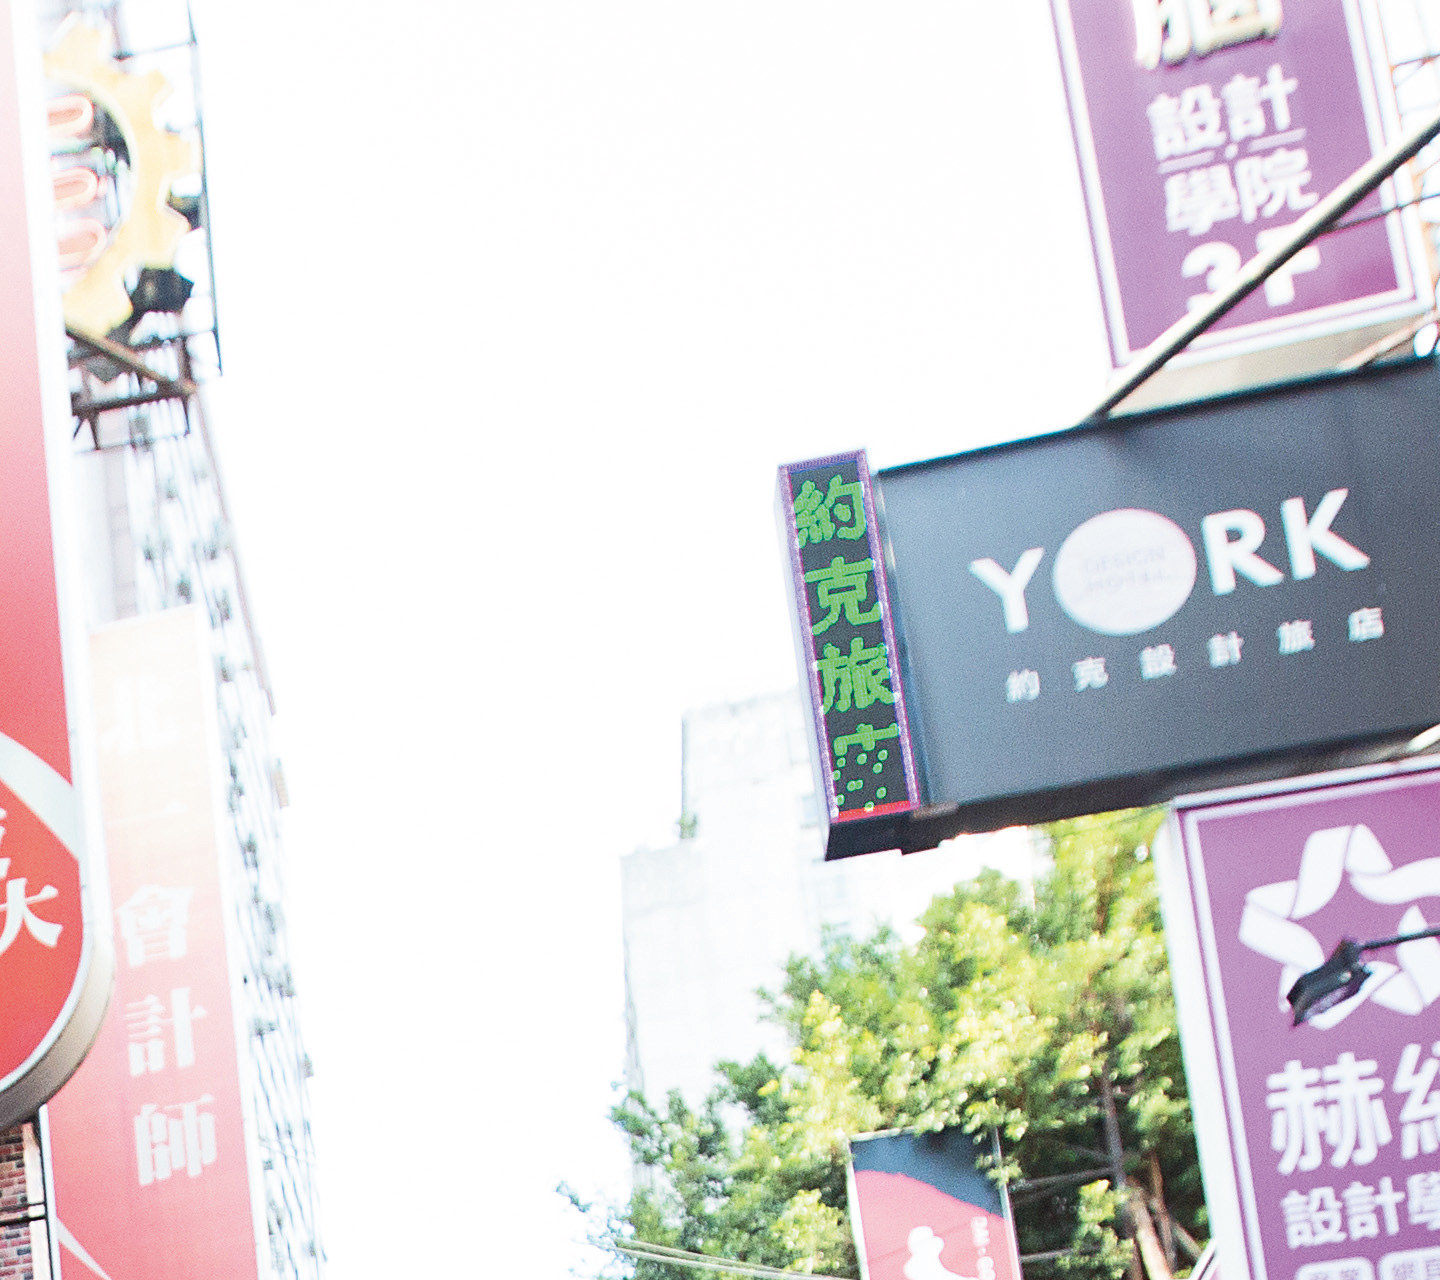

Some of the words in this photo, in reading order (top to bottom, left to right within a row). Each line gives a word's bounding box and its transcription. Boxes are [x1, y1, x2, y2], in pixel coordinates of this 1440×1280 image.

[1145, 65, 1300, 159] 設計
[1163, 146, 1318, 237] 學院
[969, 488, 1371, 635] YORK
